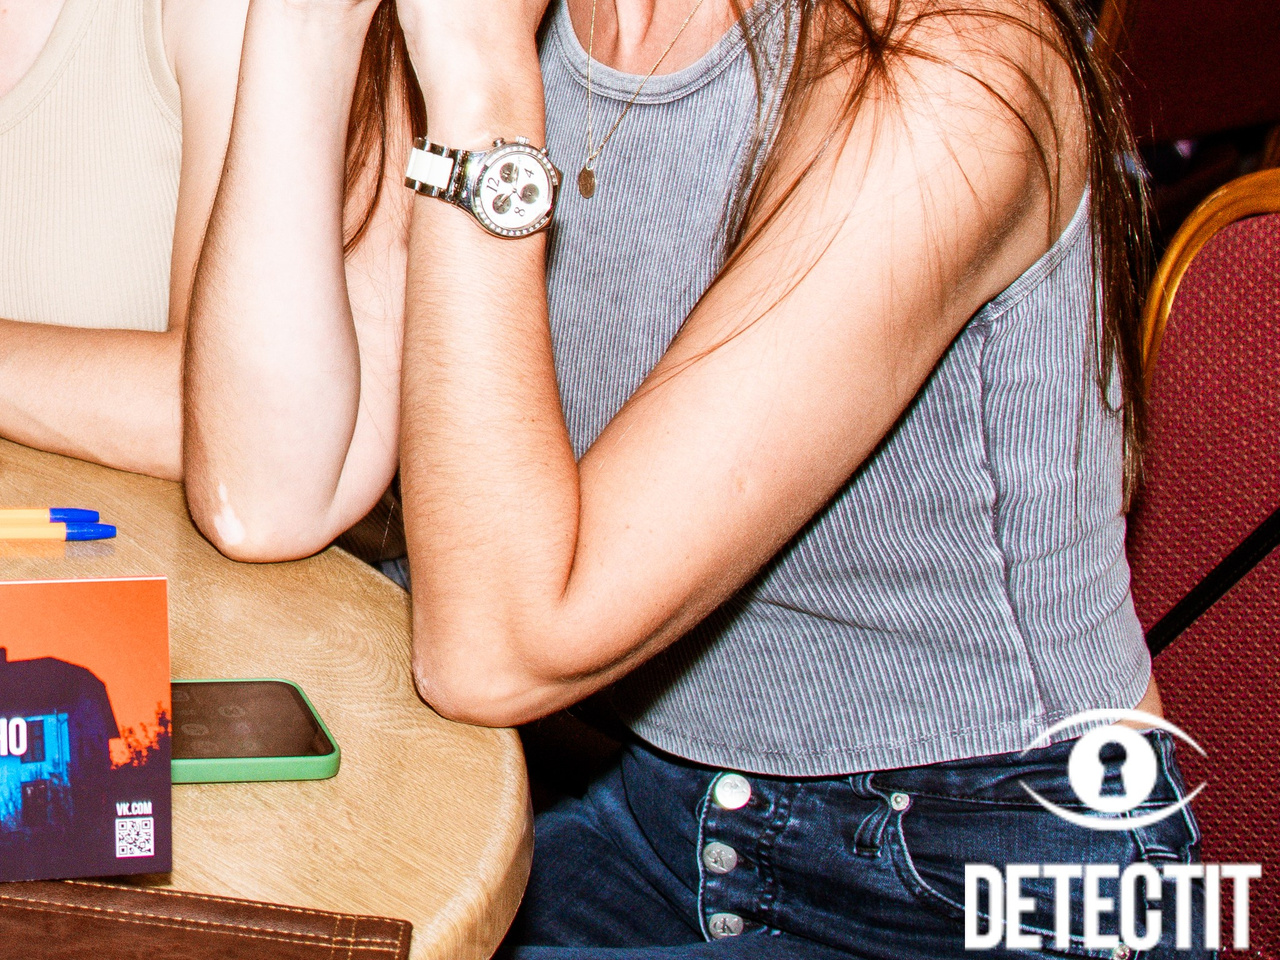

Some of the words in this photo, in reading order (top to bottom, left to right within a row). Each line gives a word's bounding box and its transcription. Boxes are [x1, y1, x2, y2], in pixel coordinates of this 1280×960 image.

[524, 168, 535, 179] 4
[486, 177, 500, 193] 12
[513, 206, 526, 217] 8
[116, 801, 153, 816] VK.COM
